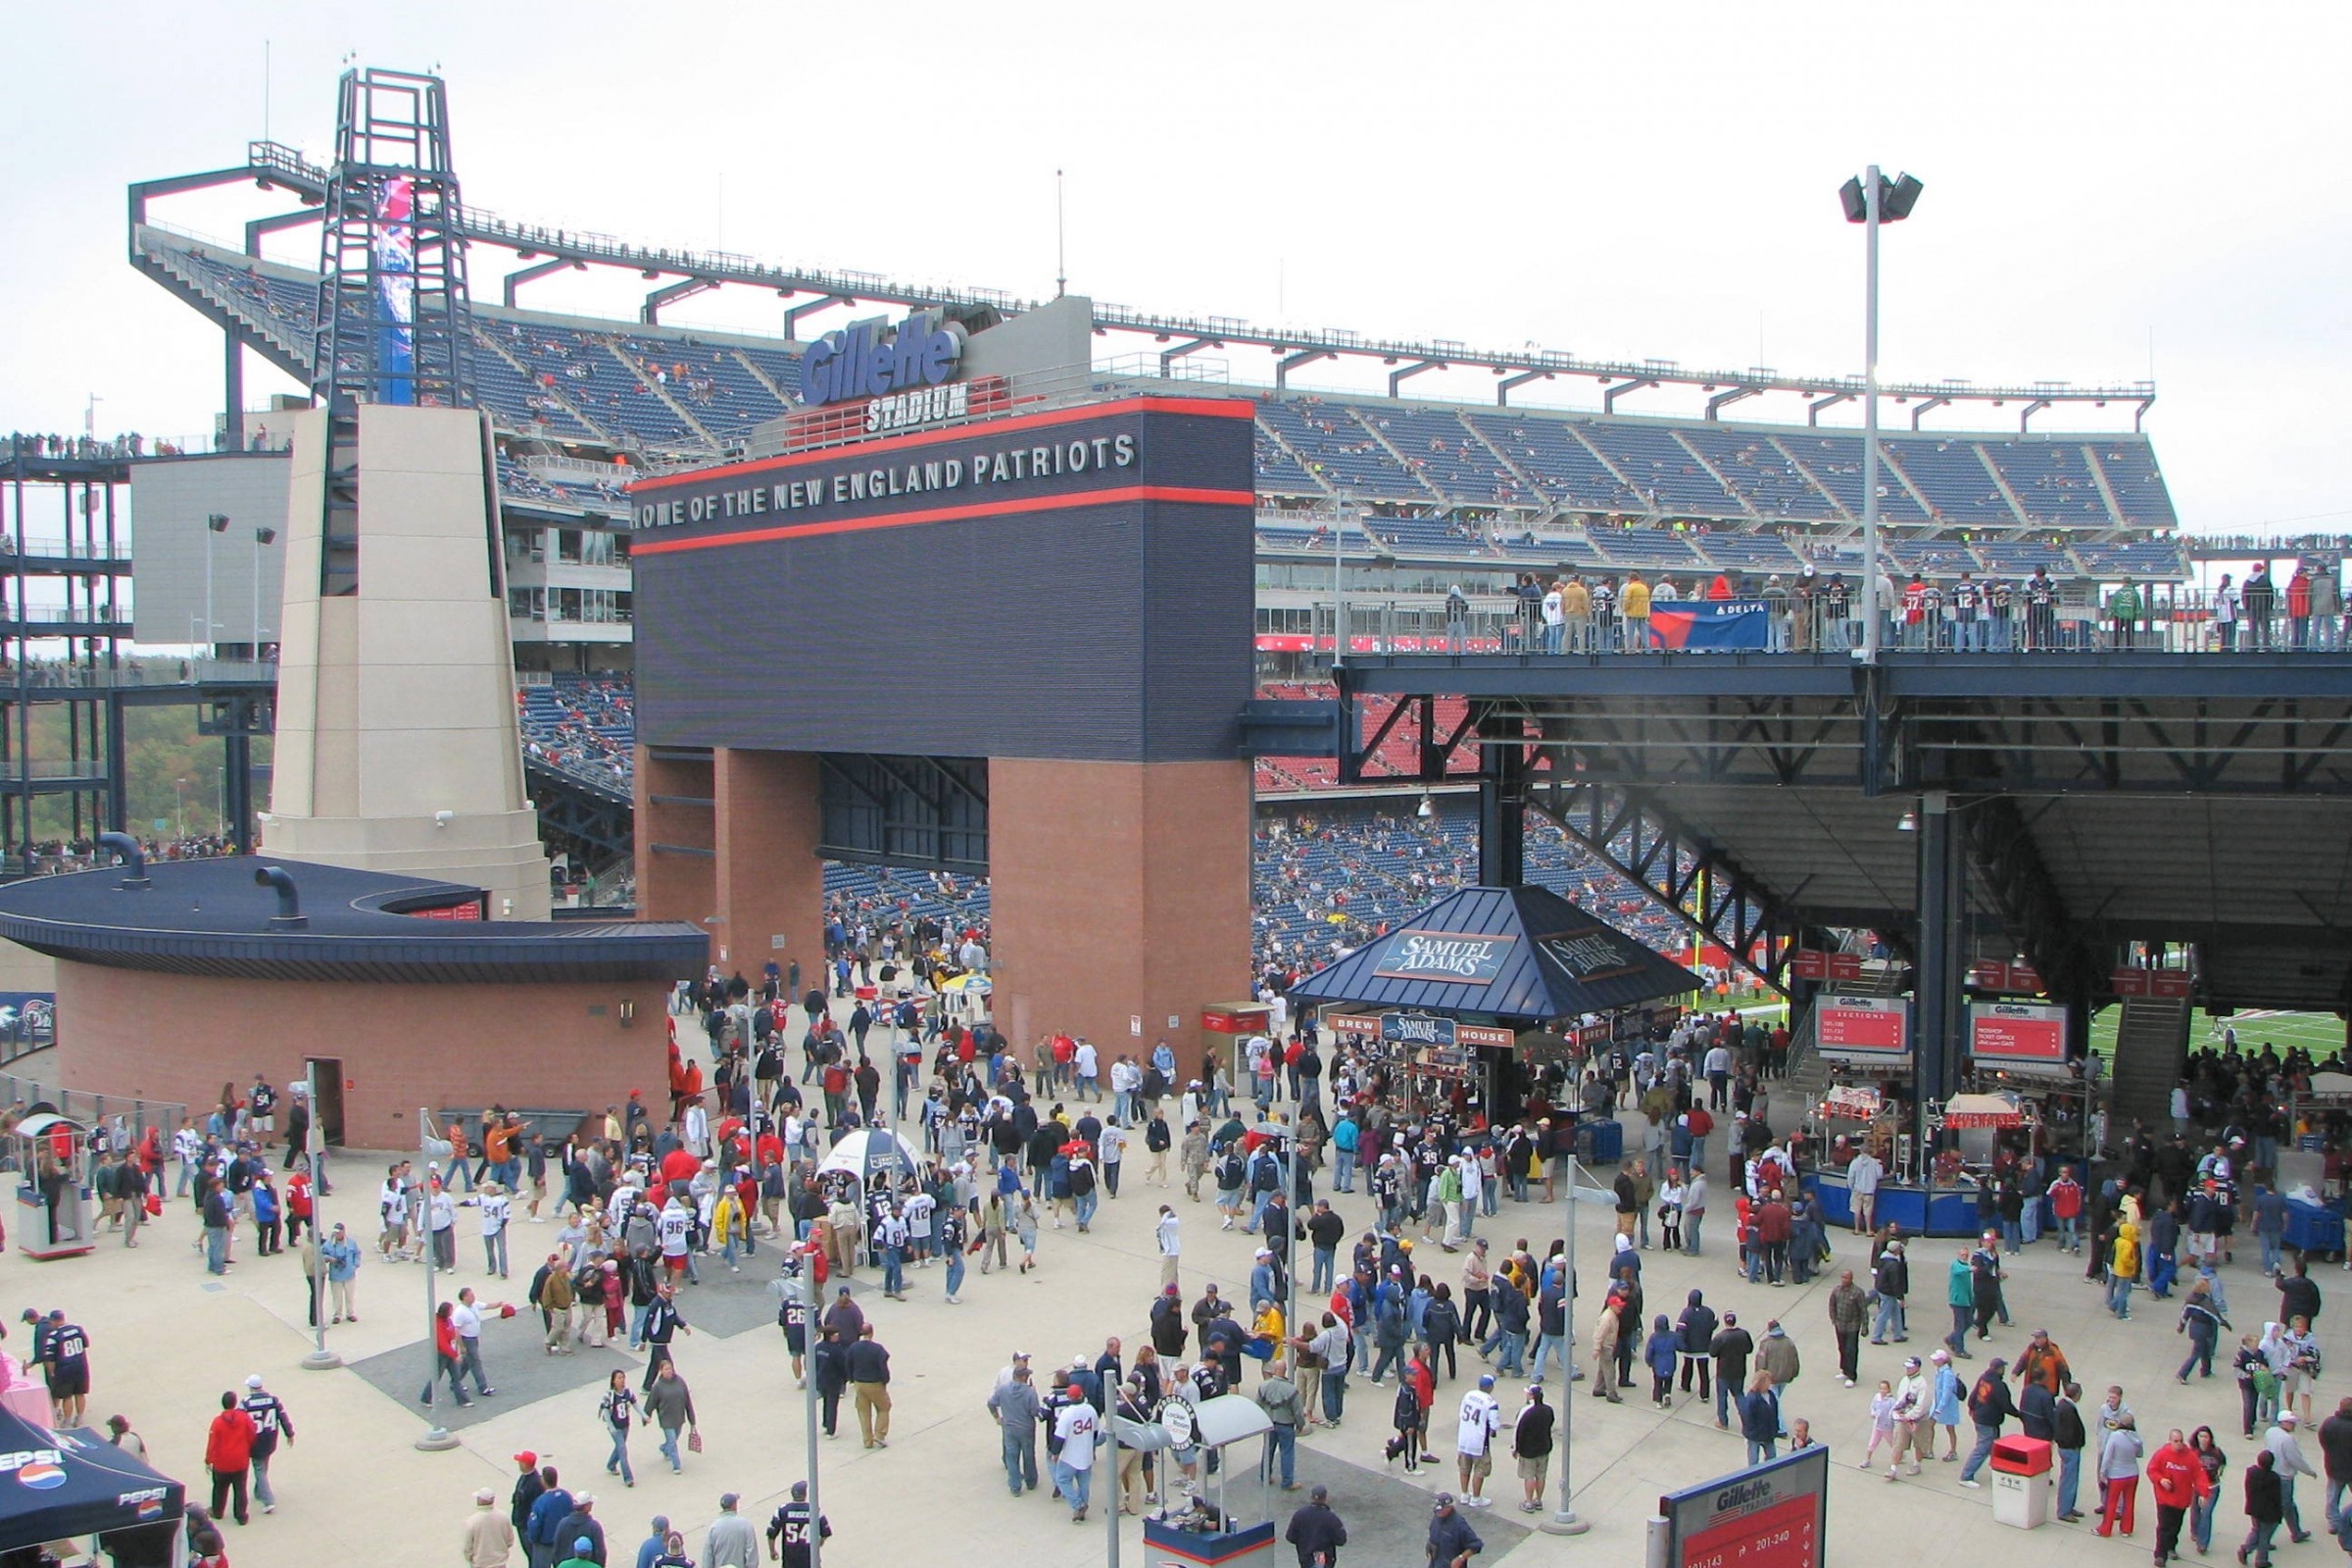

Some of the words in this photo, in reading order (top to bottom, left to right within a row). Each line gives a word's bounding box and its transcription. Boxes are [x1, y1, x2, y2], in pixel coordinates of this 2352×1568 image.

[801, 314, 961, 407] Gillette
[866, 382, 968, 431] STADIUM
[629, 500, 685, 529] HOME
[690, 495, 719, 521] OF
[722, 487, 767, 517] THE
[772, 477, 825, 511] NEW
[833, 459, 963, 503] ENGLAND
[973, 433, 1136, 485] PATRIOTS
[1727, 603, 1765, 614] DELTA
[1400, 934, 1494, 961] SAMUEL
[1549, 933, 1617, 960] SAMUEL
[1395, 954, 1481, 977] ADAMS
[1575, 949, 1628, 975] ADAMS
[1839, 998, 1873, 1007] Gillette
[1994, 1005, 2030, 1015] Gillette
[1338, 1018, 1374, 1030] BREW
[1838, 1011, 1886, 1020] SECTIONS
[1396, 1017, 1439, 1034] SAMUEL
[1400, 1028, 1437, 1044] ADAMS
[1461, 1030, 1506, 1043] HOUSE
[1612, 1057, 1623, 1070] 12
[1422, 1151, 1438, 1165] 39
[483, 1204, 499, 1219] 54
[875, 1200, 893, 1216] 12
[914, 1205, 929, 1221] 12
[666, 1220, 685, 1235] 96
[787, 1308, 806, 1325] 26
[63, 1337, 84, 1358] 80
[249, 1407, 277, 1435] 54
[1166, 1410, 1185, 1420] Locker
[1462, 1403, 1482, 1426] 54
[1073, 1416, 1094, 1436] 34
[1173, 1419, 1191, 1430] Room
[0, 1450, 65, 1472] EPSI
[119, 1487, 169, 1507] PEPSI
[1716, 1479, 1772, 1512] Gillette
[785, 1522, 811, 1544] 54
[1755, 1530, 1790, 1552] 201-240
